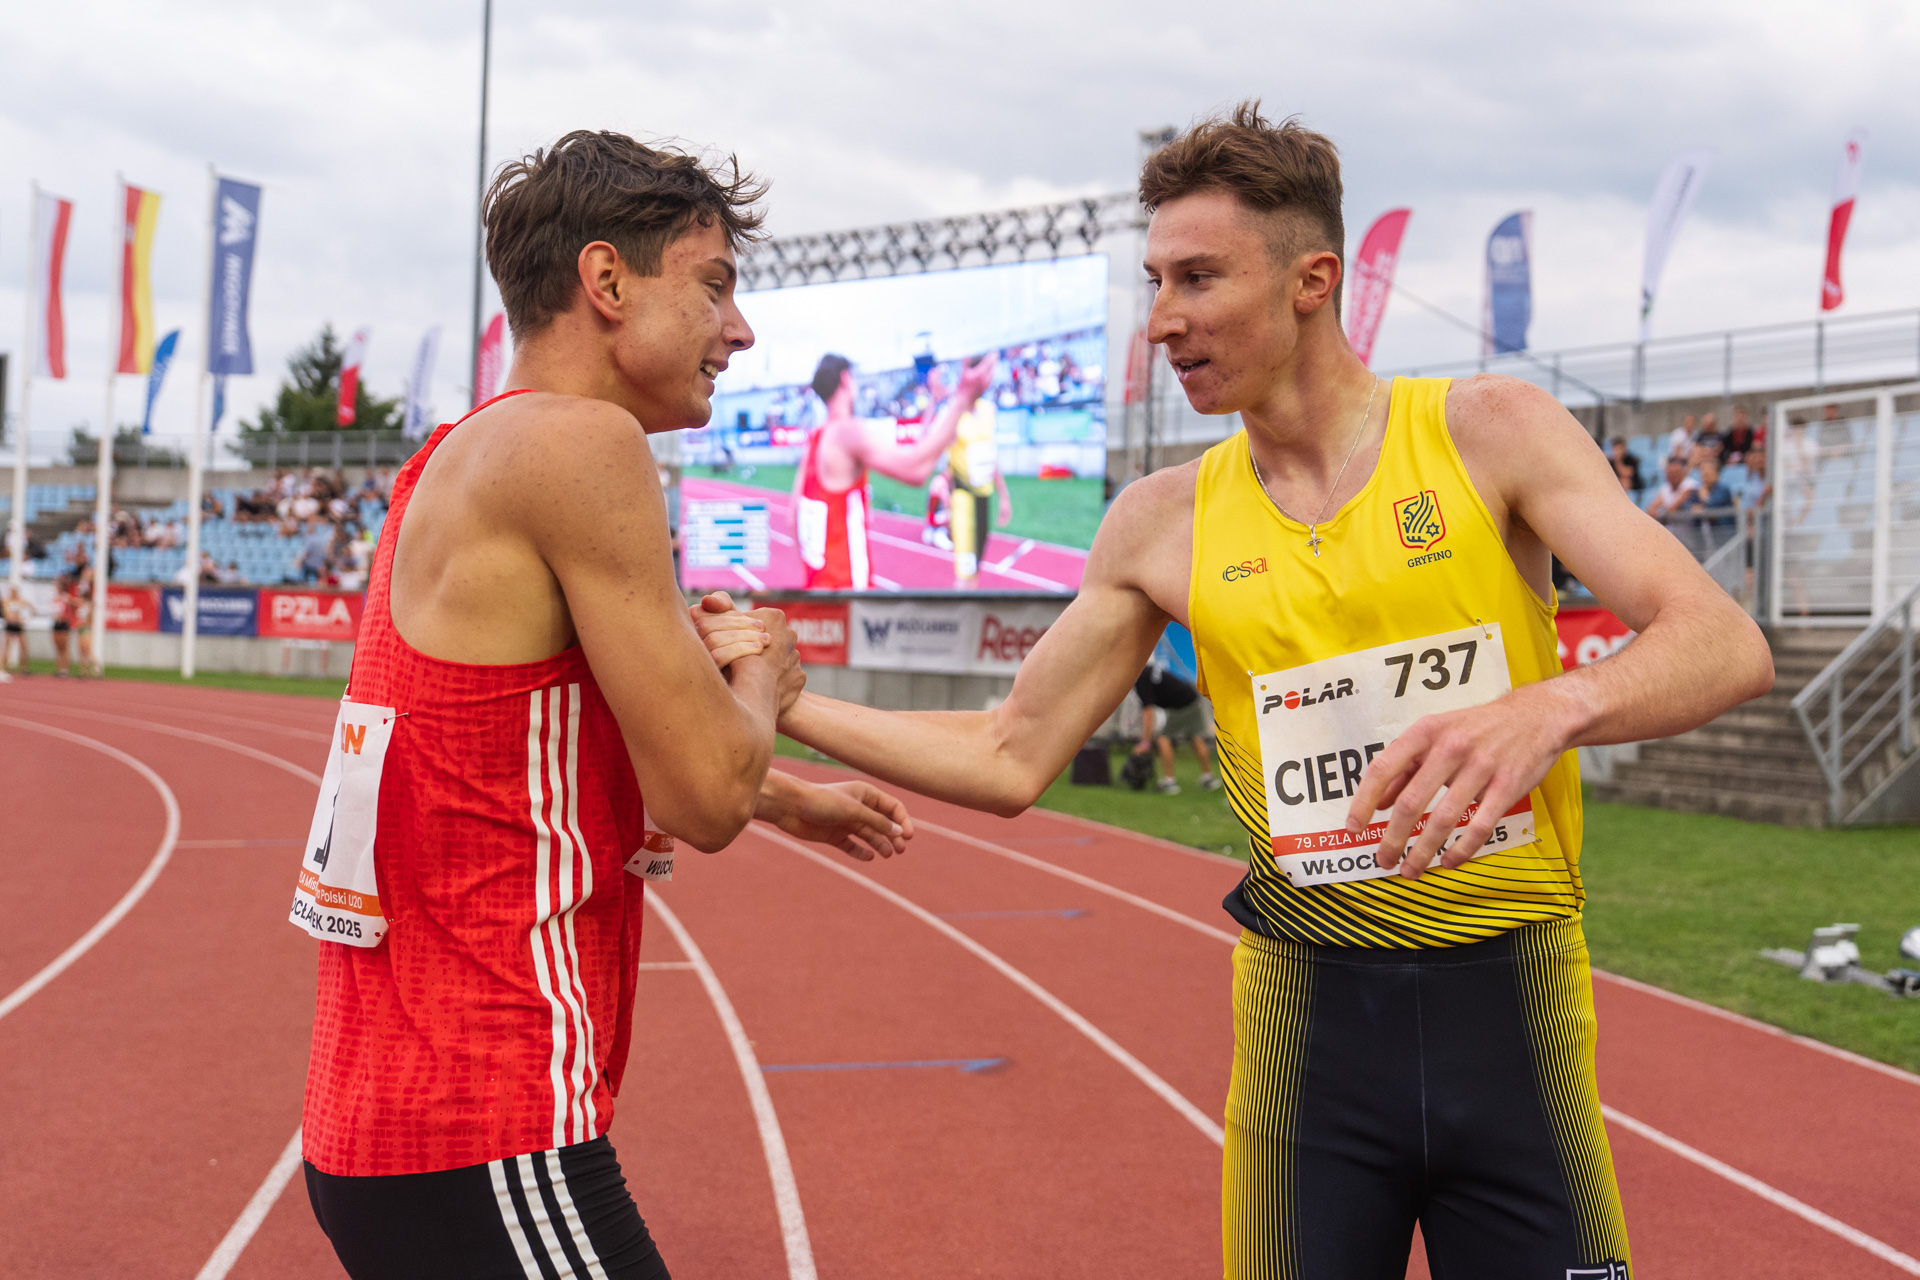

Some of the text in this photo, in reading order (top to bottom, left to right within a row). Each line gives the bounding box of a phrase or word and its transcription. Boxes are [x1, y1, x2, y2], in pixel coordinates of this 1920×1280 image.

[1407, 549, 1452, 568] GRYFINO
[1384, 640, 1478, 699] 737
[1262, 677, 1354, 715] POLAR
[1294, 837, 1316, 849] 79.
[1319, 832, 1352, 847] PZLA
[320, 888, 347, 905] Polski
[348, 894, 363, 909] U20
[326, 915, 362, 939] 2025
